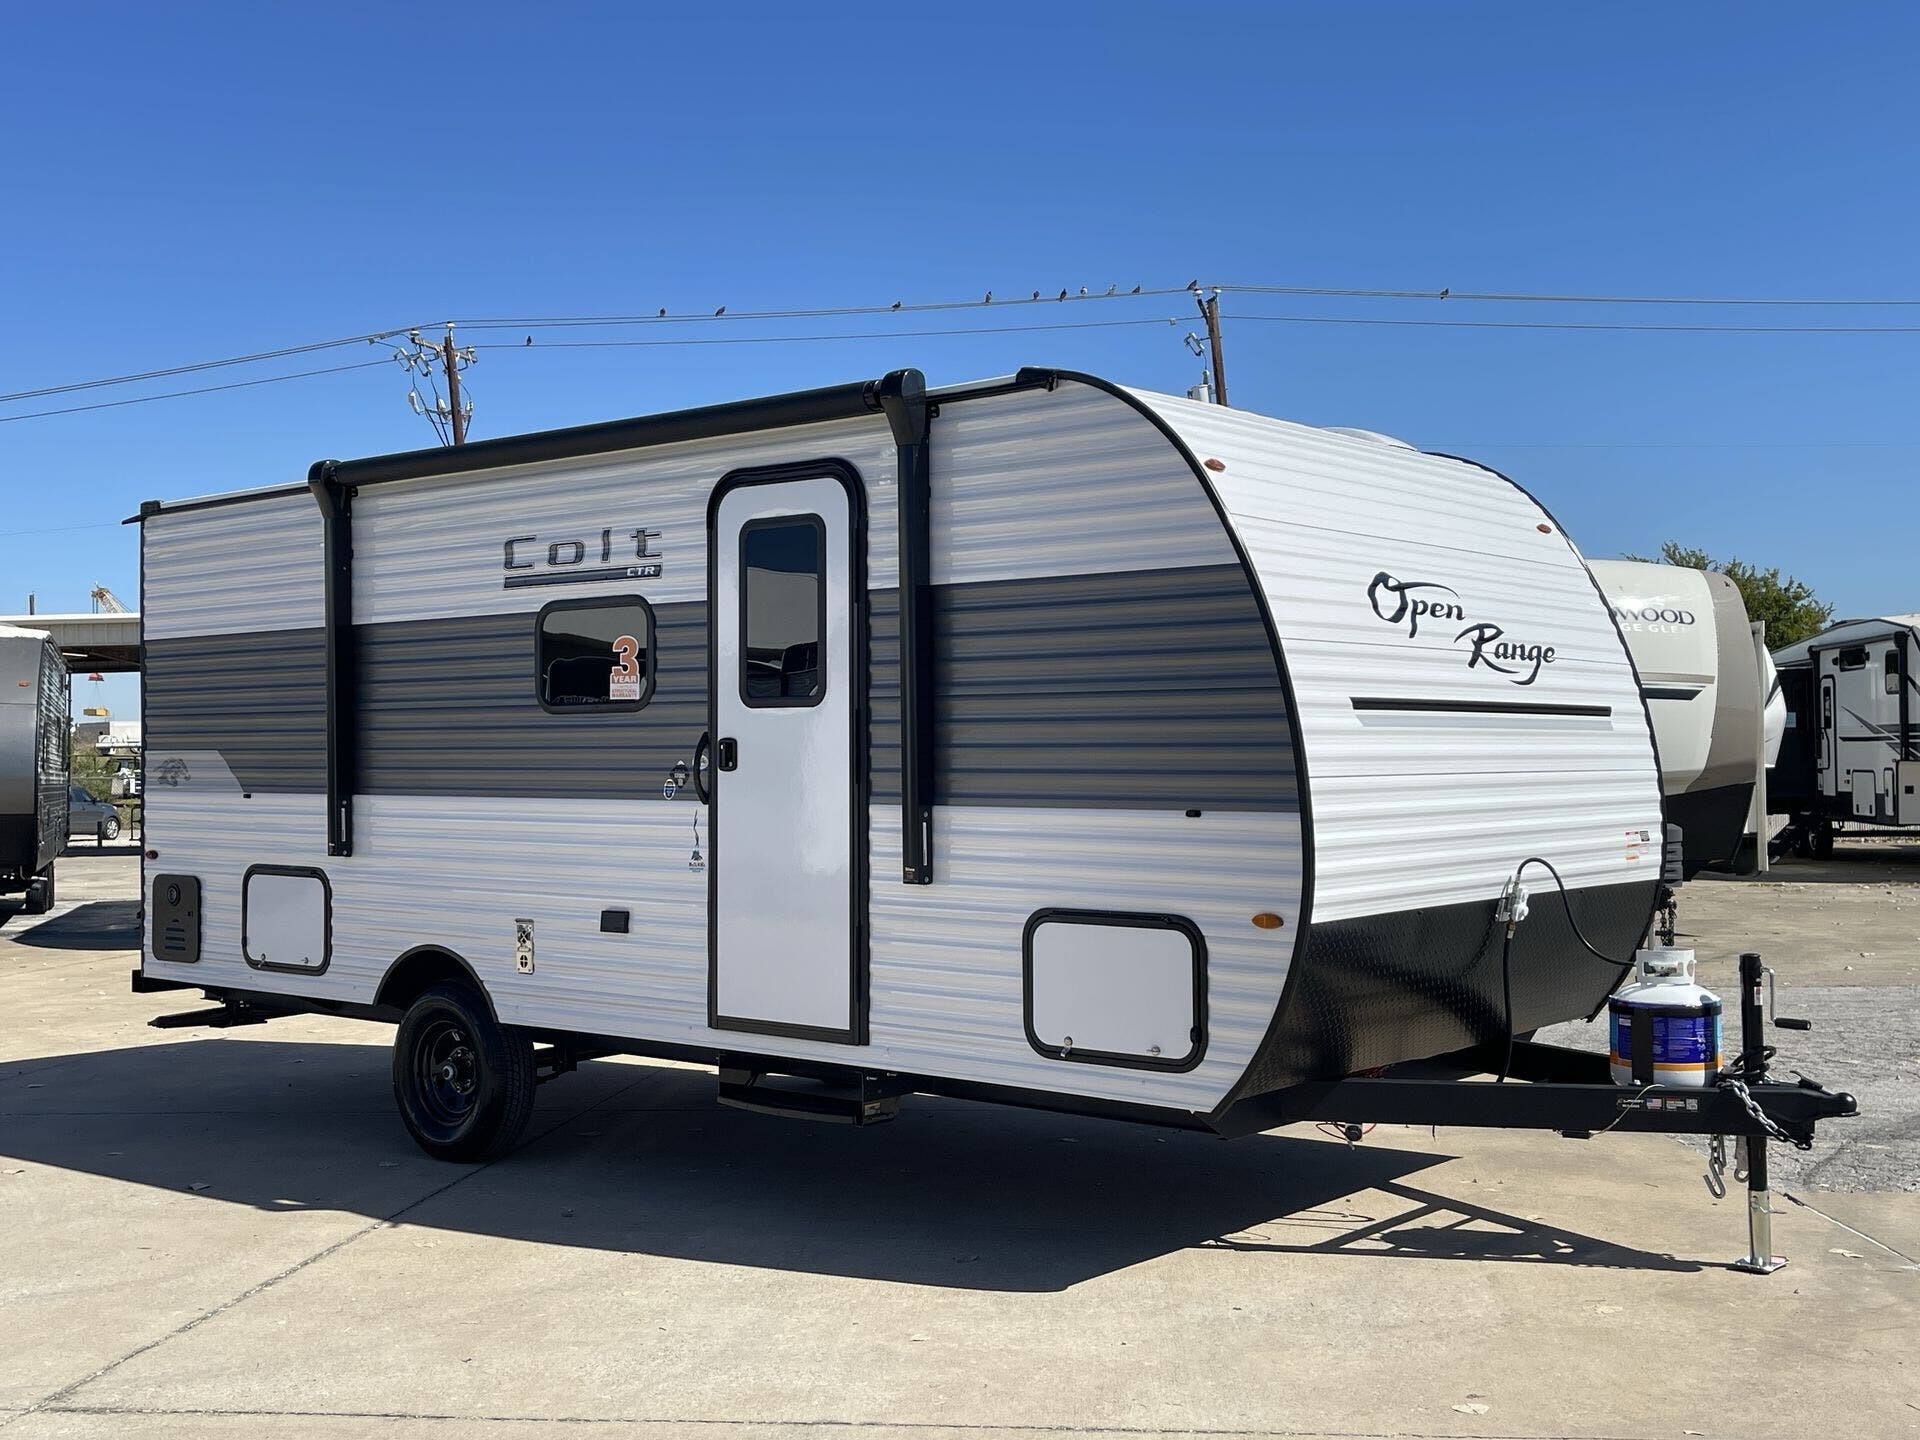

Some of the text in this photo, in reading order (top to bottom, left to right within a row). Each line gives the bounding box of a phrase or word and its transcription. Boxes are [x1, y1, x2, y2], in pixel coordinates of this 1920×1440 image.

[504, 527, 662, 570] Colt
[626, 566, 656, 577] CTR
[1367, 571, 1466, 639] Open
[1613, 607, 1696, 625] WOOD
[611, 634, 640, 676] 3
[1454, 622, 1556, 686] Range
[613, 676, 637, 684] YEAR
